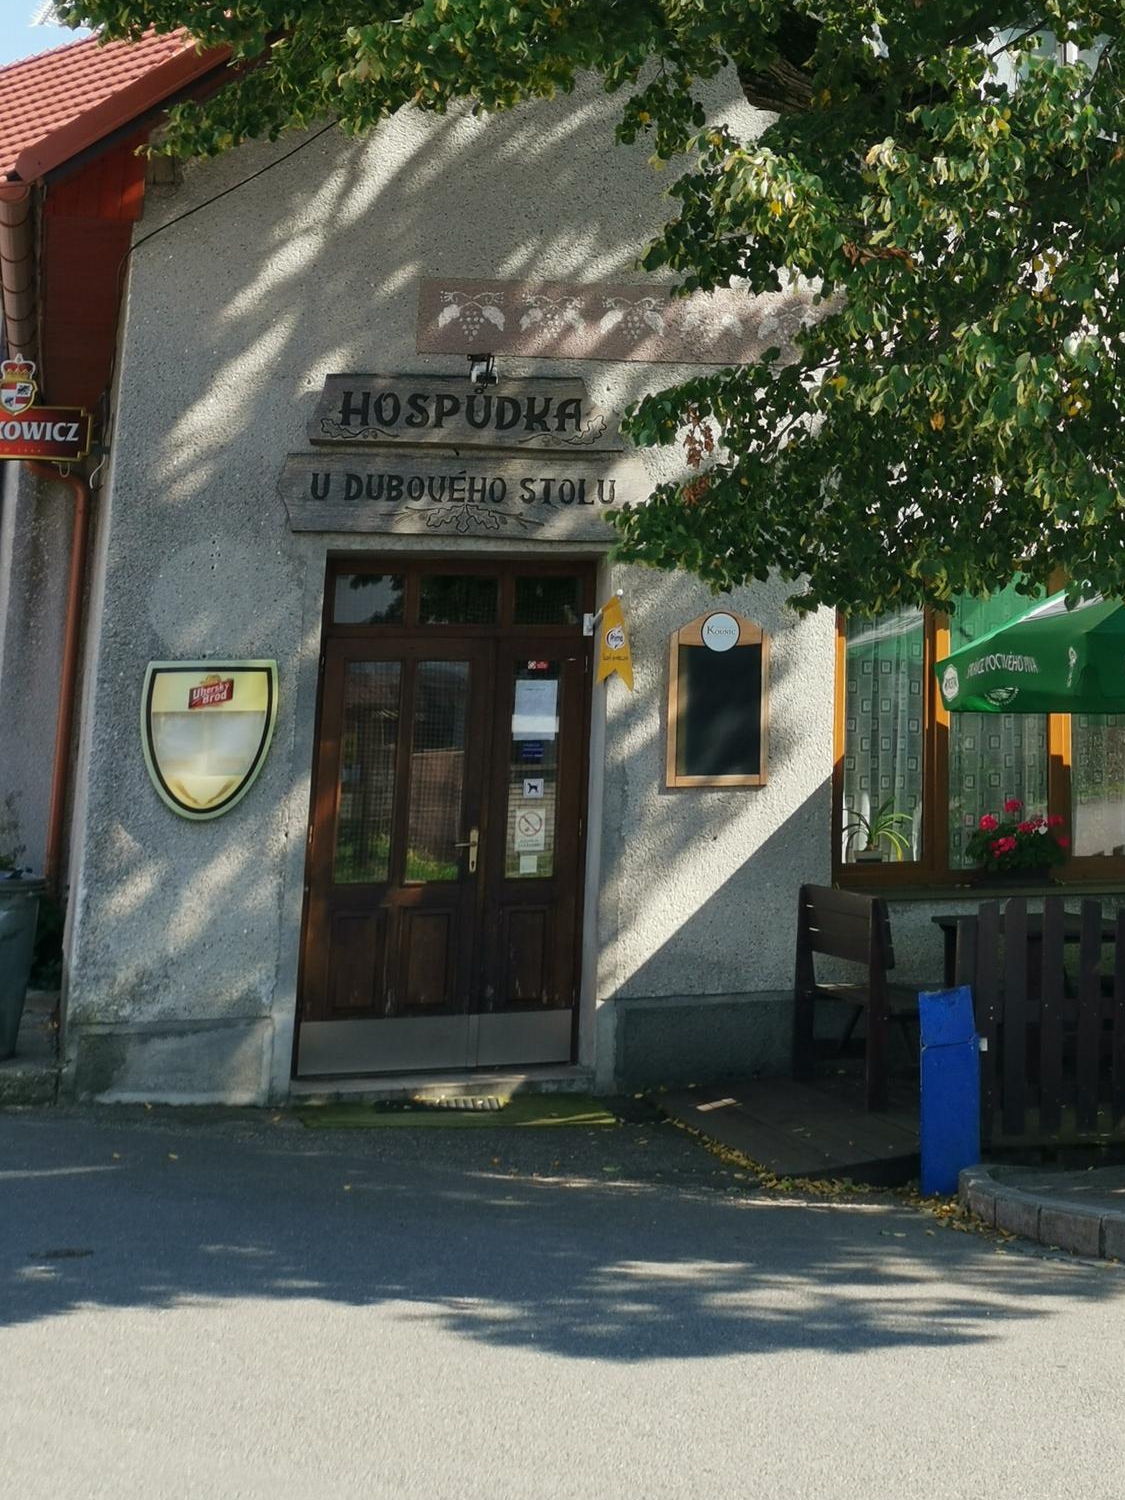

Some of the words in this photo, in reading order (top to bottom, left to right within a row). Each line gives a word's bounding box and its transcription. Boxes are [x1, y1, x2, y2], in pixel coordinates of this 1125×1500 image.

[339, 387, 584, 432] HOSPŮDKA
[311, 472, 331, 501] U
[344, 470, 507, 503] DUBOVÉHO
[519, 477, 617, 506] STOLU
